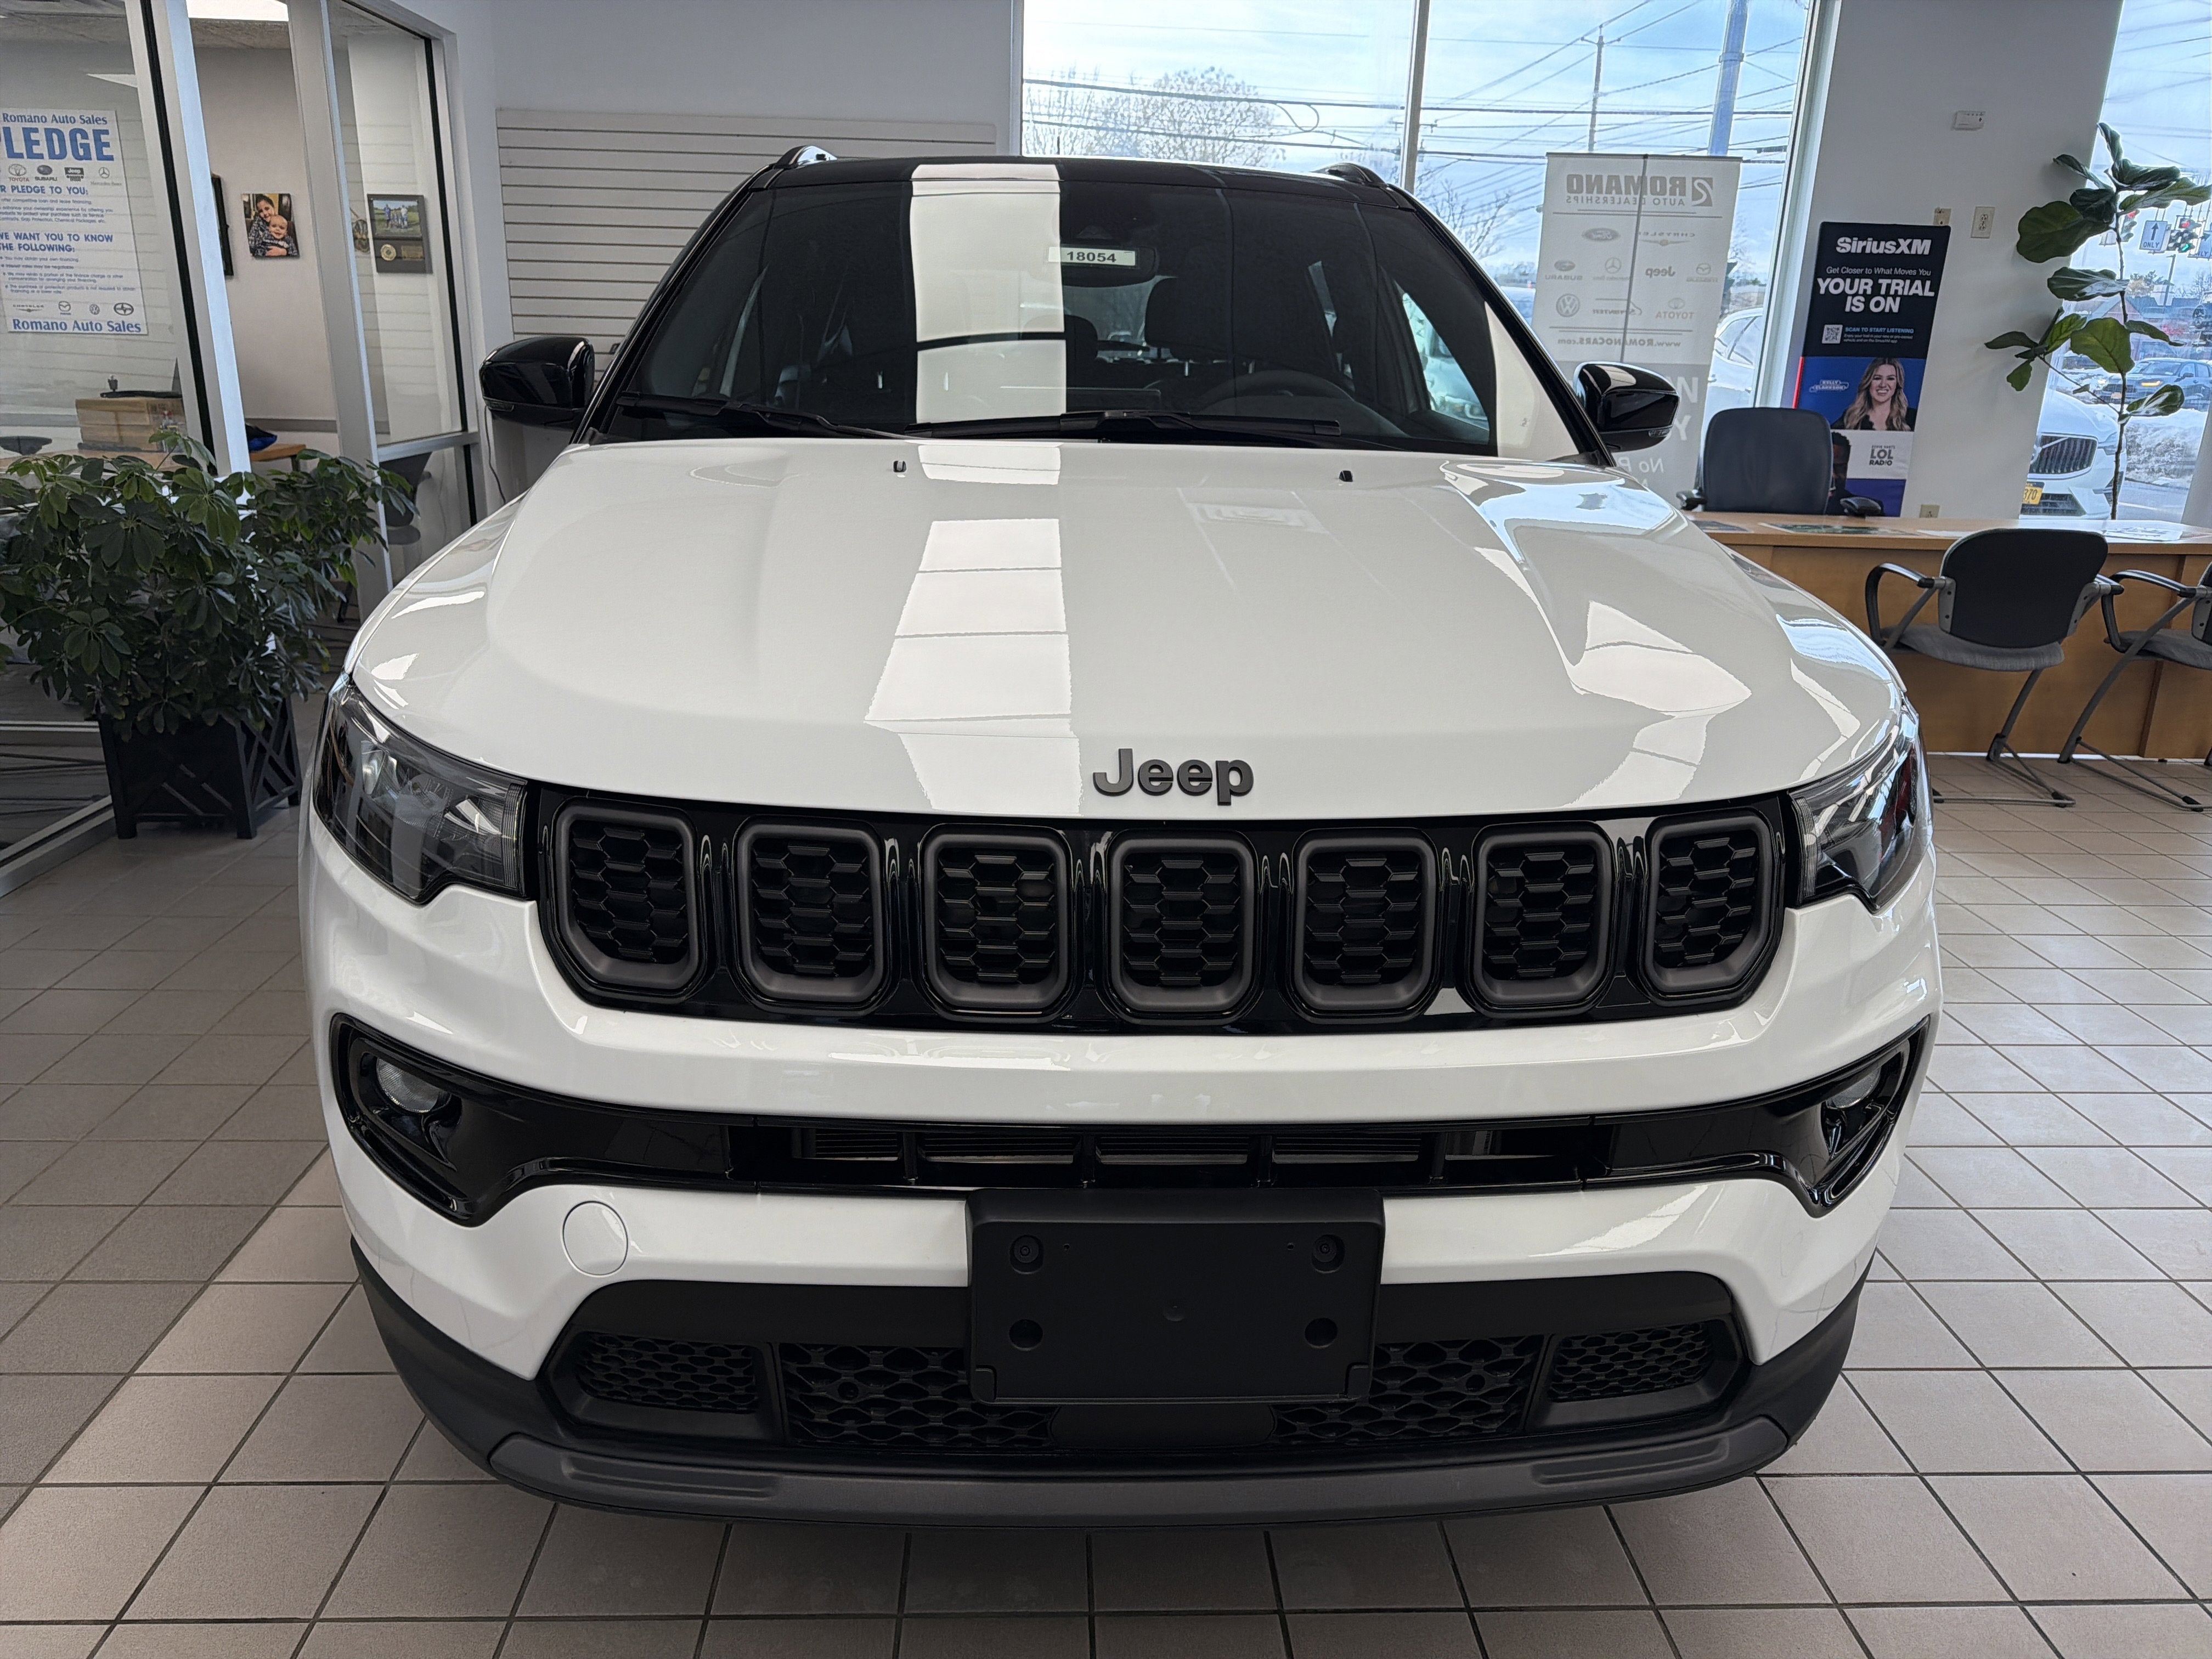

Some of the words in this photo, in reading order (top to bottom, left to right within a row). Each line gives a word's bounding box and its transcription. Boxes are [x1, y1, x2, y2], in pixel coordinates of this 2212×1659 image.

[3, 113, 47, 123] Romano
[51, 114, 76, 124] Auto
[79, 115, 108, 125] Sales
[0, 127, 114, 161] LEDGE
[11, 185, 46, 194] PLEDGE
[49, 186, 62, 194] TO
[66, 187, 88, 195] YOU:
[13, 232, 40, 240] WANT
[44, 233, 63, 241] YOU
[67, 234, 80, 242] TO
[84, 234, 113, 242] KNOW
[18, 243, 75, 252] FOLLOWING:
[1836, 237, 1931, 255] SiriusXM
[1066, 251, 1116, 263] 18054
[1841, 266, 1864, 274] Closer
[1817, 278, 1874, 295] YOUR
[1878, 279, 1935, 297] TRIAL
[1845, 296, 1865, 313] IS
[1869, 296, 1901, 313] ON
[13, 319, 67, 330] Romano
[72, 320, 103, 332] Auto
[107, 320, 142, 332] Sales
[1870, 449, 1893, 460] LOL
[1092, 748, 1254, 806] Jeep
